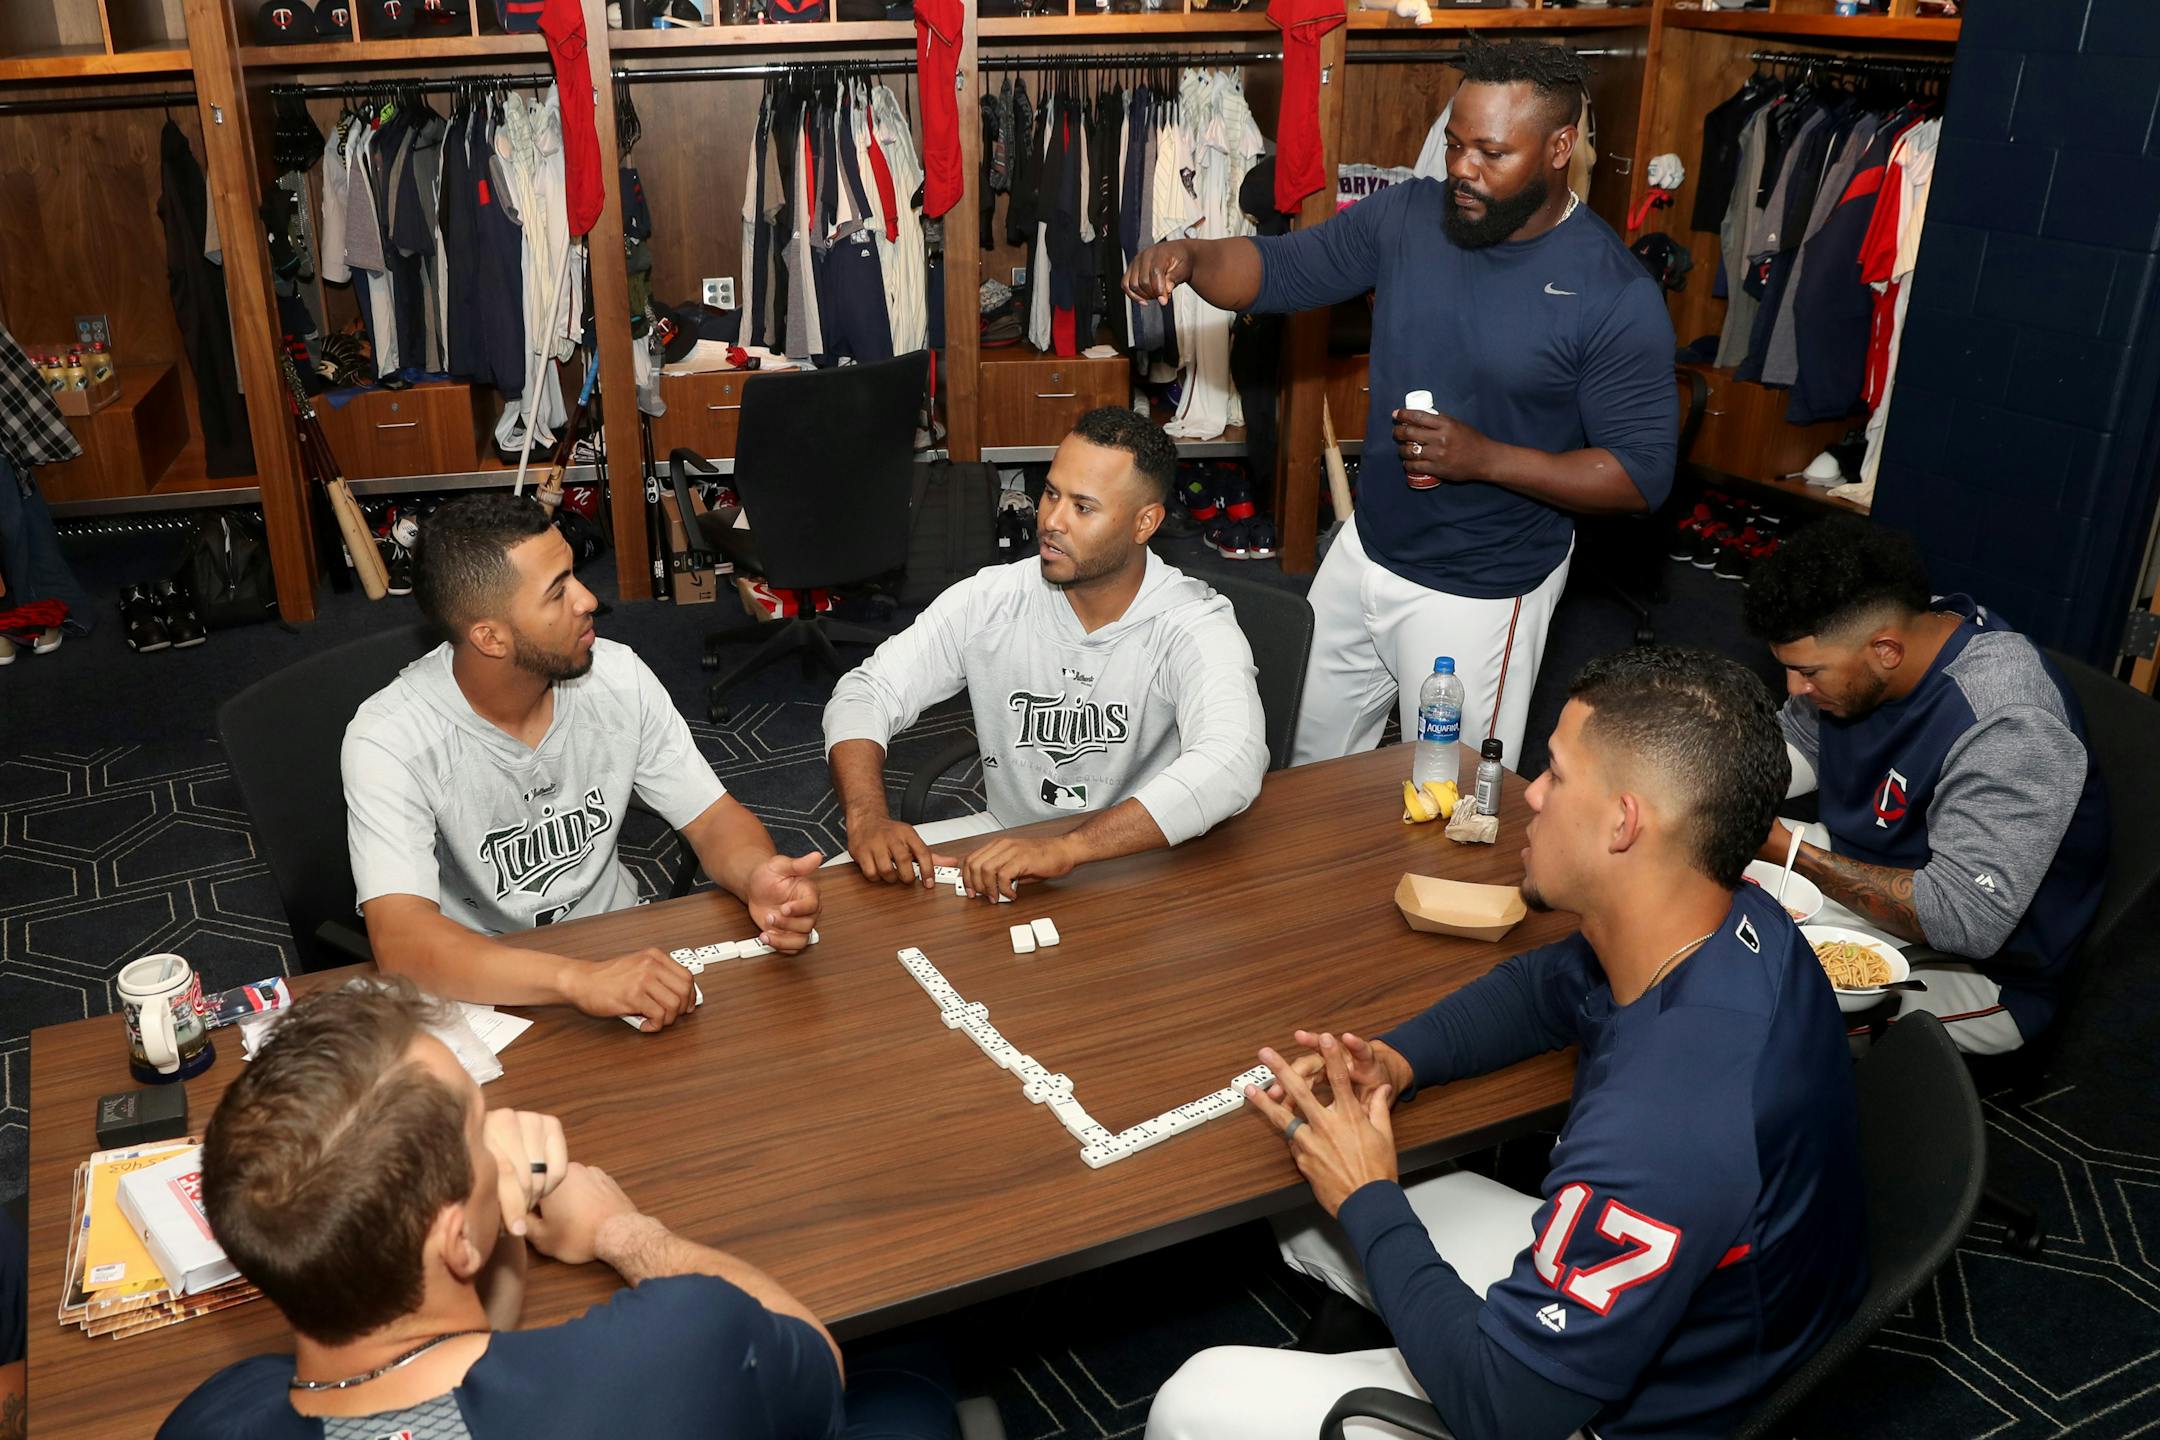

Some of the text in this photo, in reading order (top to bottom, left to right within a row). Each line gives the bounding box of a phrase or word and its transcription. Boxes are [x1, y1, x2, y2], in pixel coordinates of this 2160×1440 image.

[1008, 689, 1129, 749] Twins
[1427, 722, 1459, 734] AQUAFINA
[477, 785, 612, 902] Twins
[1533, 1180, 1683, 1318] 17
